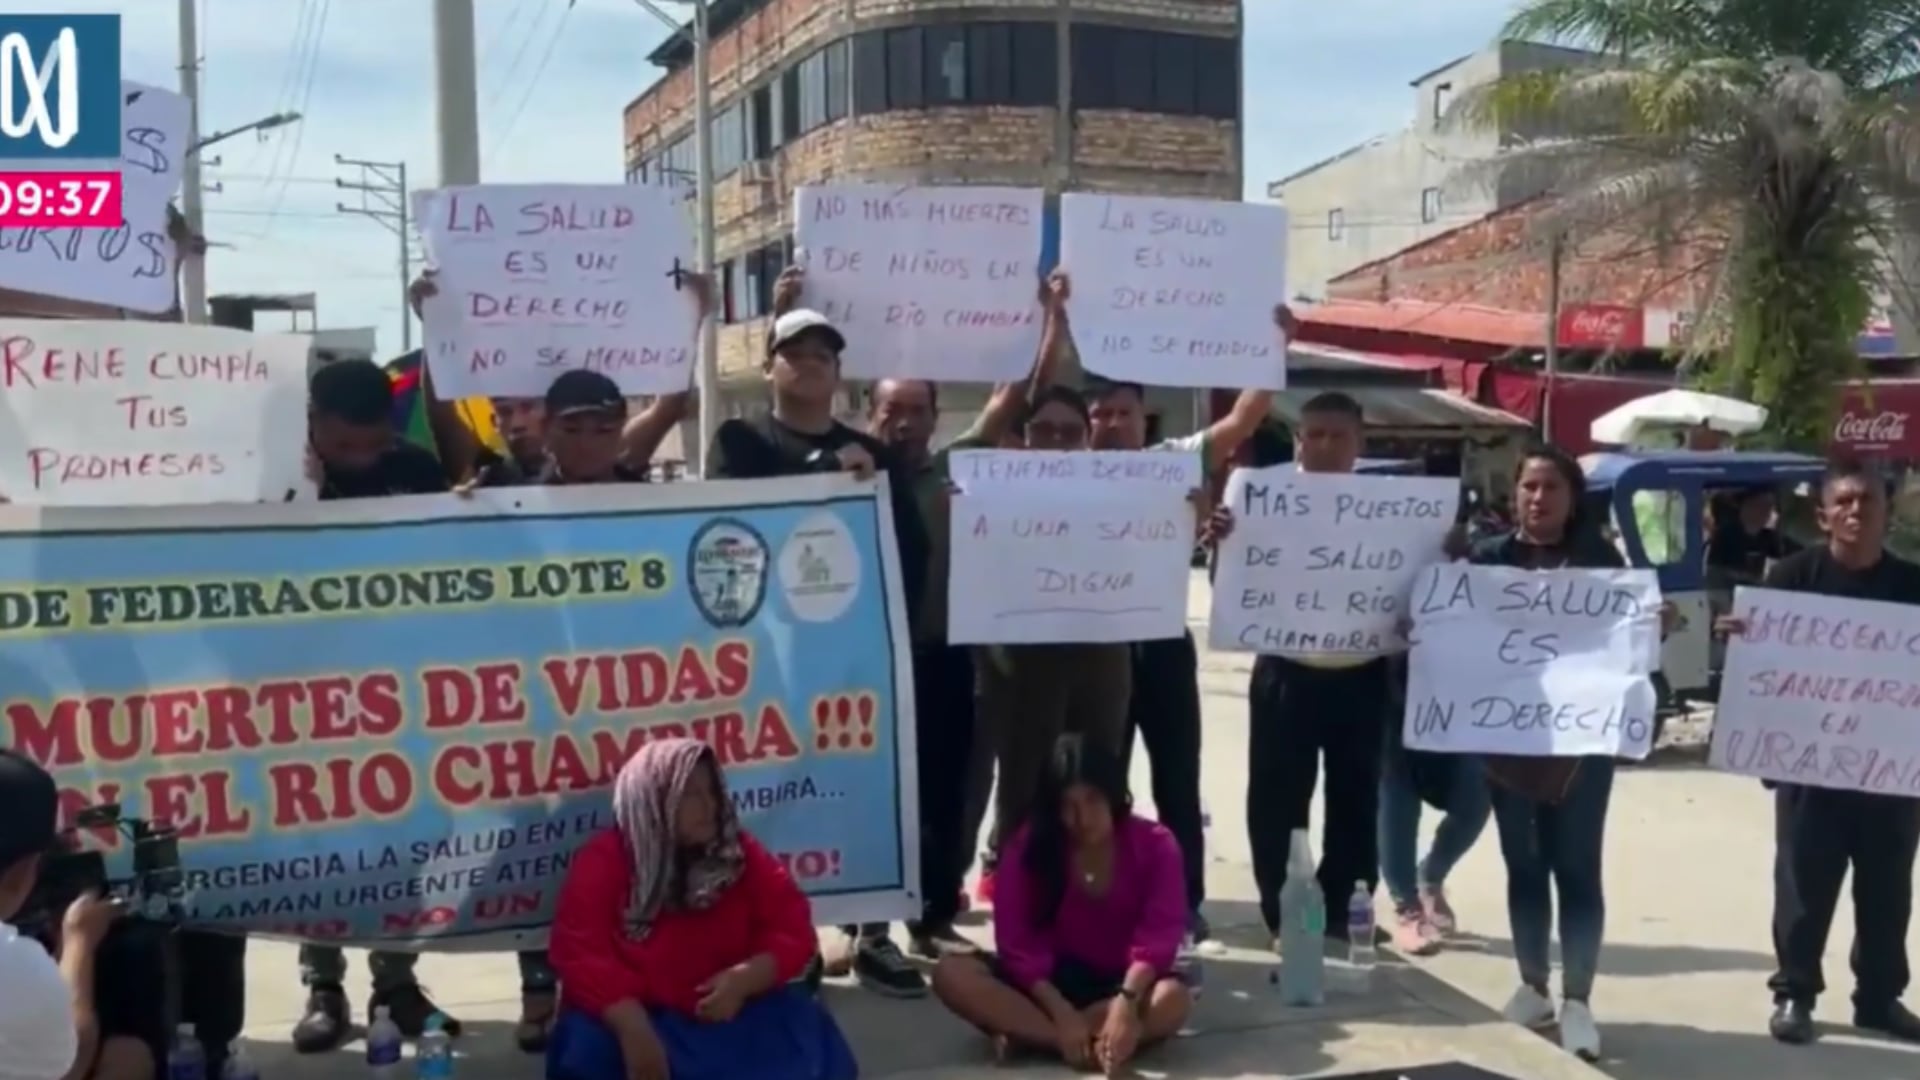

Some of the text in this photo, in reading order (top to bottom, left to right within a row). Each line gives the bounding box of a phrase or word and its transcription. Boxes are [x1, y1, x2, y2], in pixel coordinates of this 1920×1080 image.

[447, 196, 634, 236] LA SALUD
[815, 197, 846, 222] NO
[928, 203, 1030, 225] MUERTES
[1100, 198, 1227, 236] LA SALUD
[504, 251, 620, 274] ES UN
[823, 247, 1020, 280] DE NIÑOS EN
[1135, 248, 1213, 268] ES UN
[467, 293, 630, 319] DERECHO
[1110, 286, 1226, 309] DERECHO
[536, 350, 570, 367] SE
[1150, 335, 1180, 356] SE
[1, 335, 124, 389] RENE
[966, 452, 1185, 483] TENEMOS DERECHO
[1335, 494, 1444, 525] PUESTOS
[973, 513, 1177, 541] A UNA SALUD
[1245, 542, 1404, 571] DE SALUD
[0, 559, 666, 630] DE FEDERACIONES LOTE 8
[1036, 567, 1134, 594] DIGNA
[1420, 567, 1642, 617] LA SALUD
[1241, 588, 1275, 609] EN
[1295, 590, 1327, 612] EL
[1238, 624, 1380, 650] CHAMBIRA
[1498, 629, 1560, 666] ES
[6, 641, 749, 767] MUERTES DE VIDAS
[1414, 695, 1647, 742] UN DERECHO
[1820, 712, 1862, 735] EN
[145, 770, 249, 838] EL
[269, 753, 412, 826] RIO
[358, 845, 398, 871] LA
[411, 828, 516, 866] SALUD
[527, 818, 566, 845] EN
[334, 866, 487, 907] URGENTE
